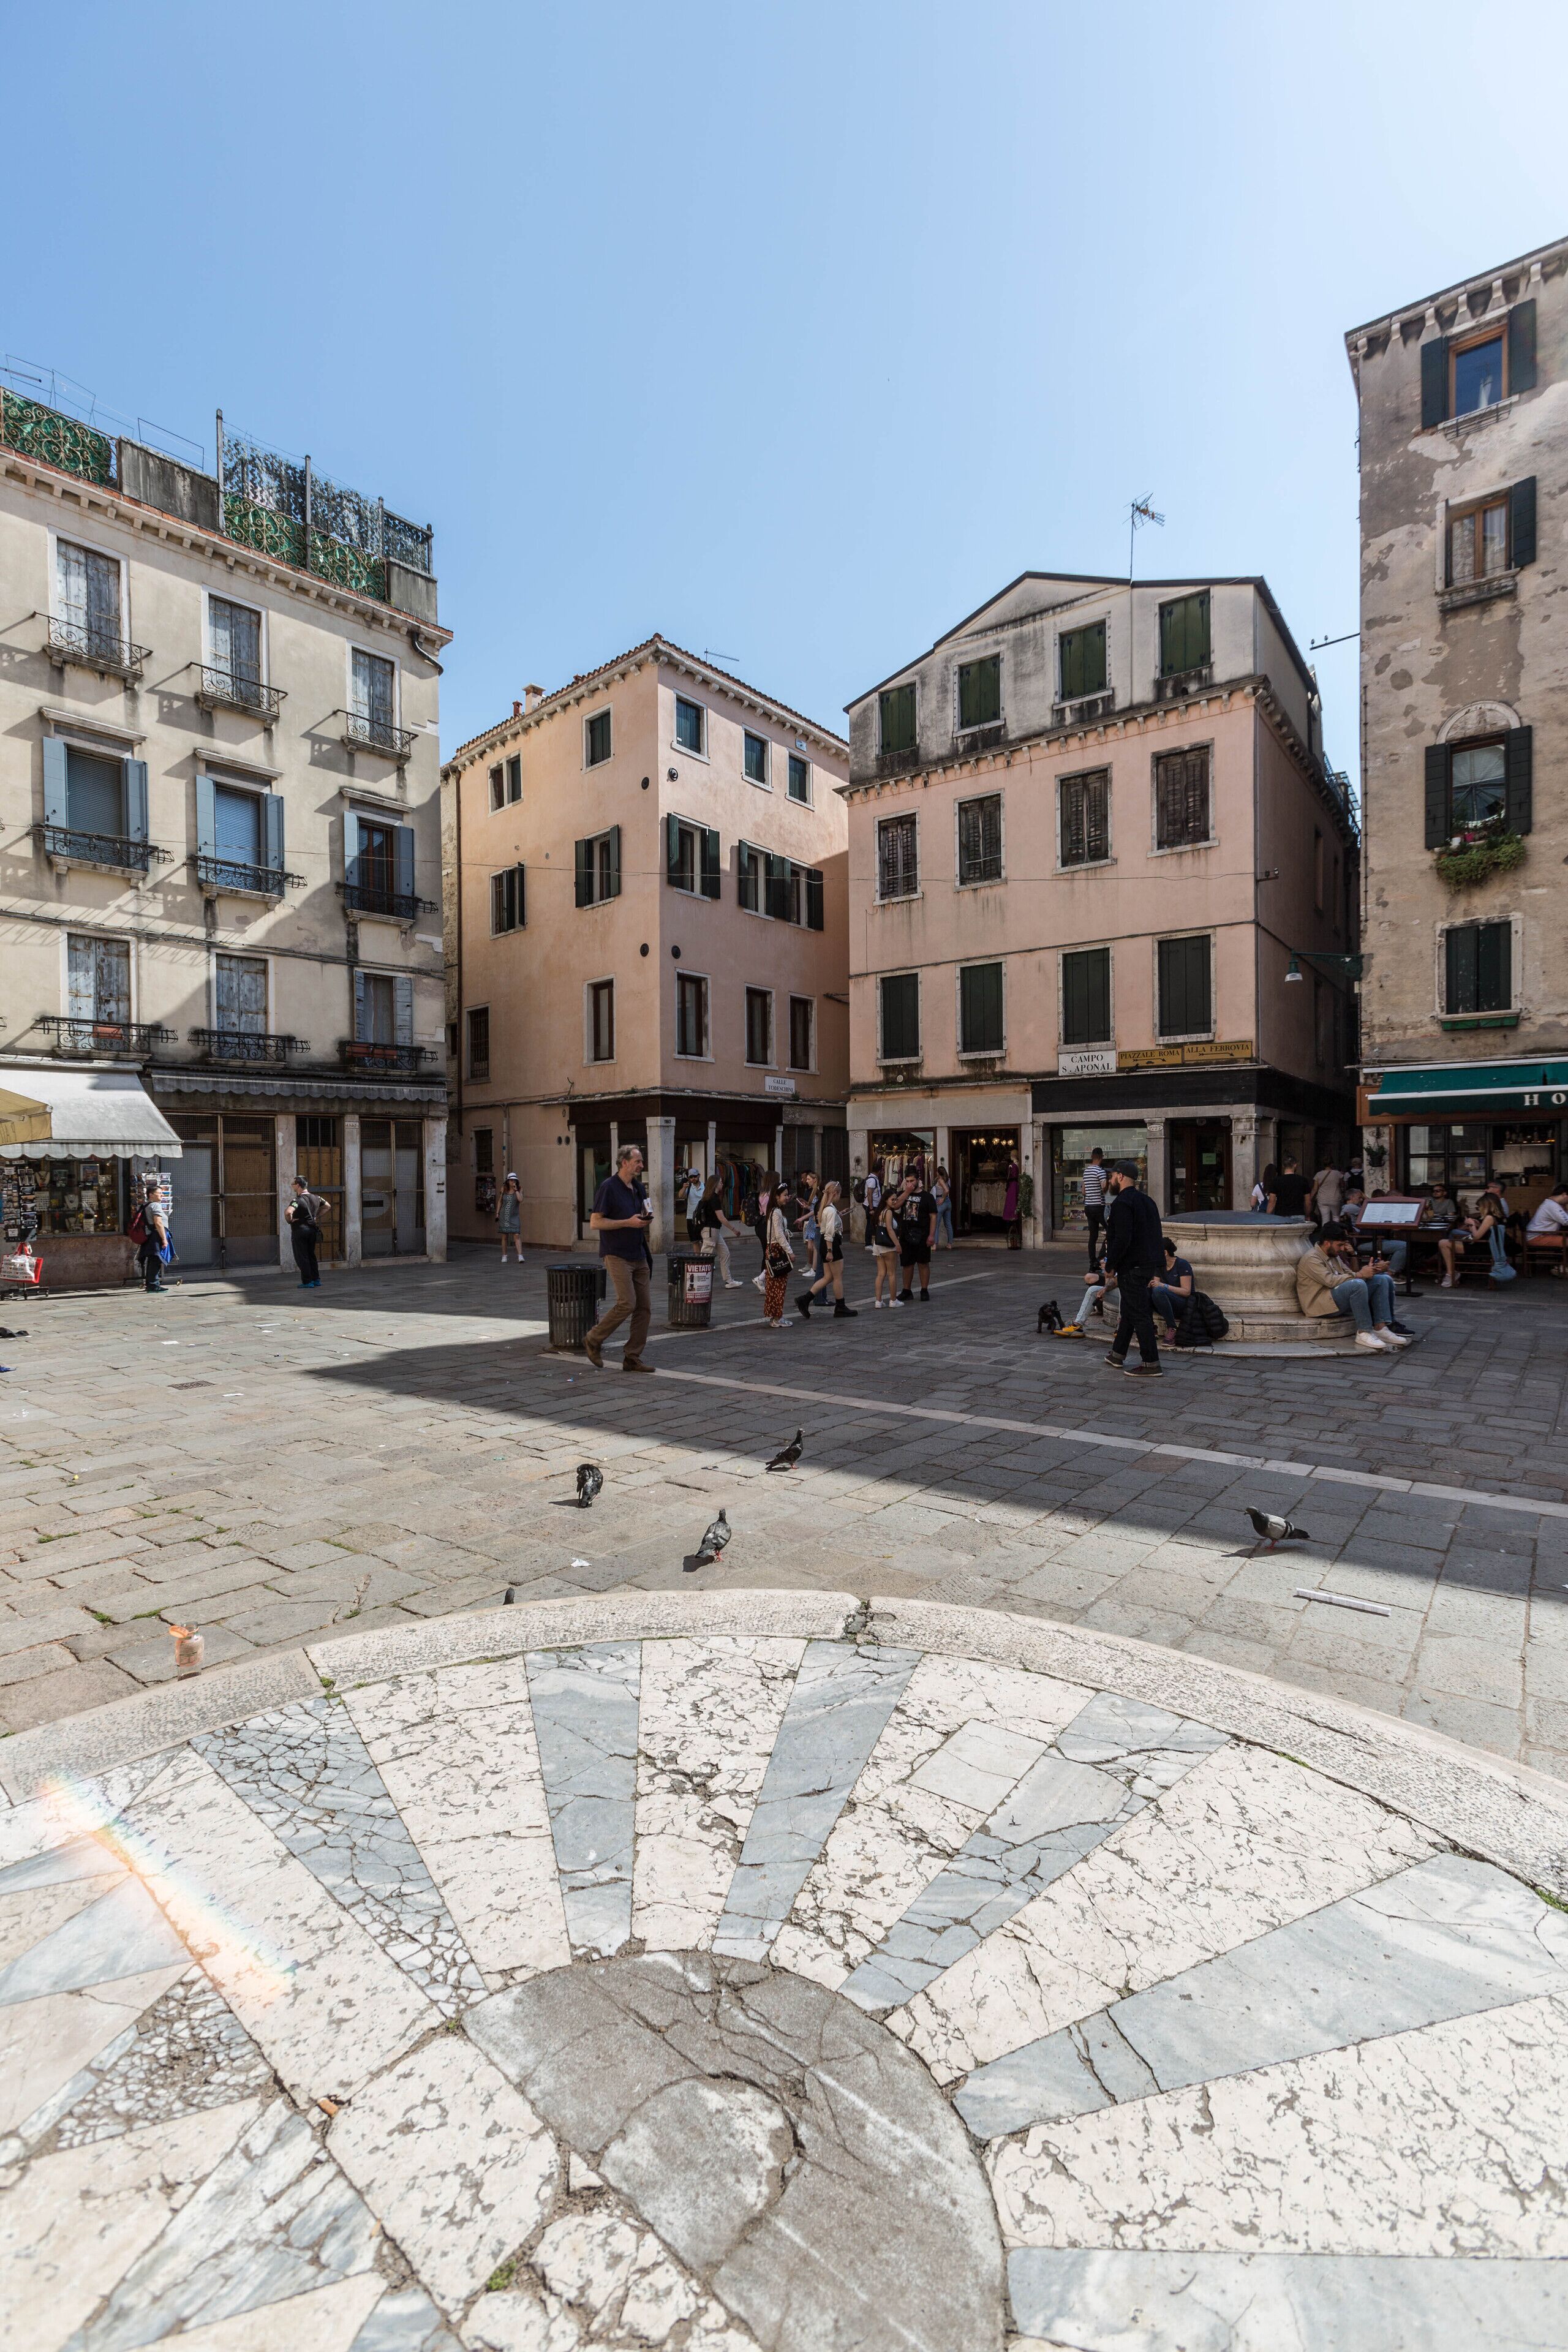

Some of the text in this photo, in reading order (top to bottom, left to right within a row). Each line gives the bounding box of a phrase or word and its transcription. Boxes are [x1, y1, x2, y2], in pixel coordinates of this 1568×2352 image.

[1210, 1044, 1250, 1052] FERROVIA
[1071, 1054, 1104, 1063] CAMPO
[1075, 1063, 1113, 1072] APONAL
